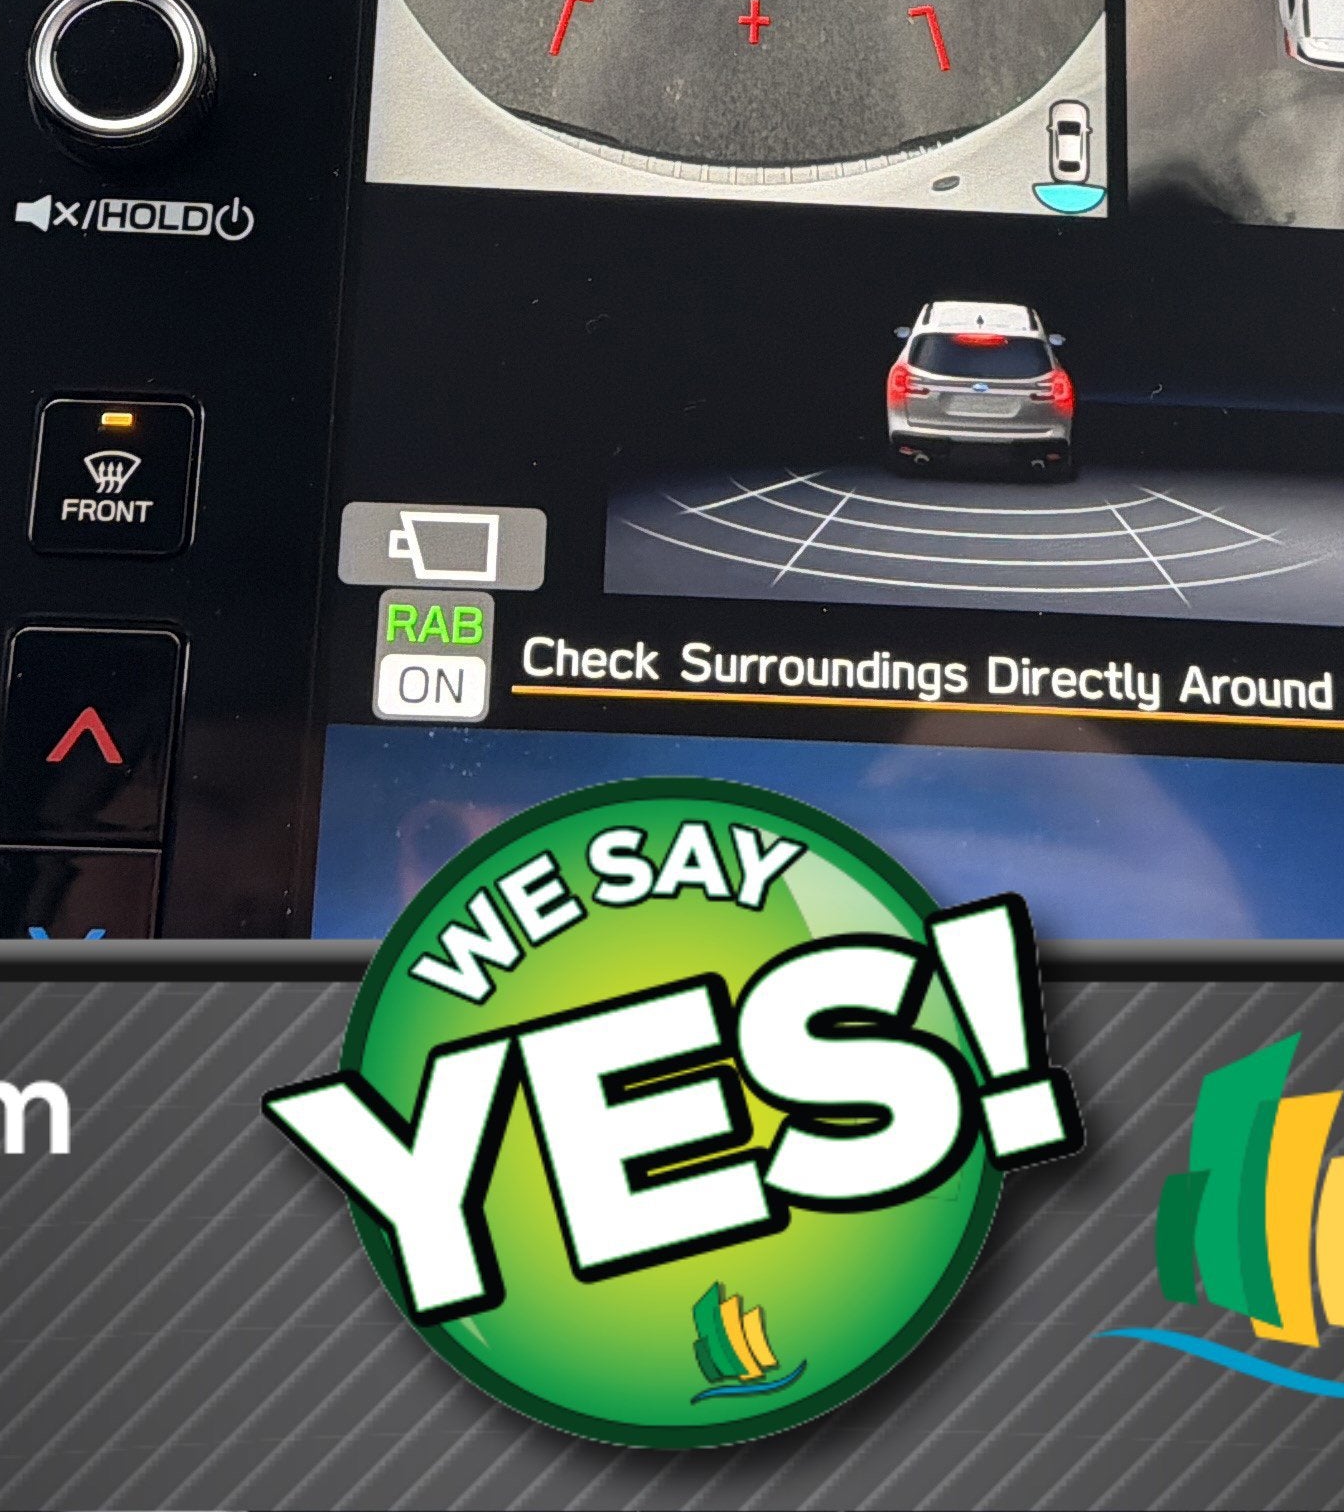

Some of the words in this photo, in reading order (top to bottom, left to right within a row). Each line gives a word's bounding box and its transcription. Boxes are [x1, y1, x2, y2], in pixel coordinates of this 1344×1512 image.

[62, 499, 153, 522] FRONT
[386, 604, 483, 645] RAB
[396, 664, 468, 708] ON
[522, 637, 660, 681] Check
[680, 643, 969, 700] Surroundings
[987, 656, 1160, 711] Directly
[1179, 666, 1333, 710] Around
